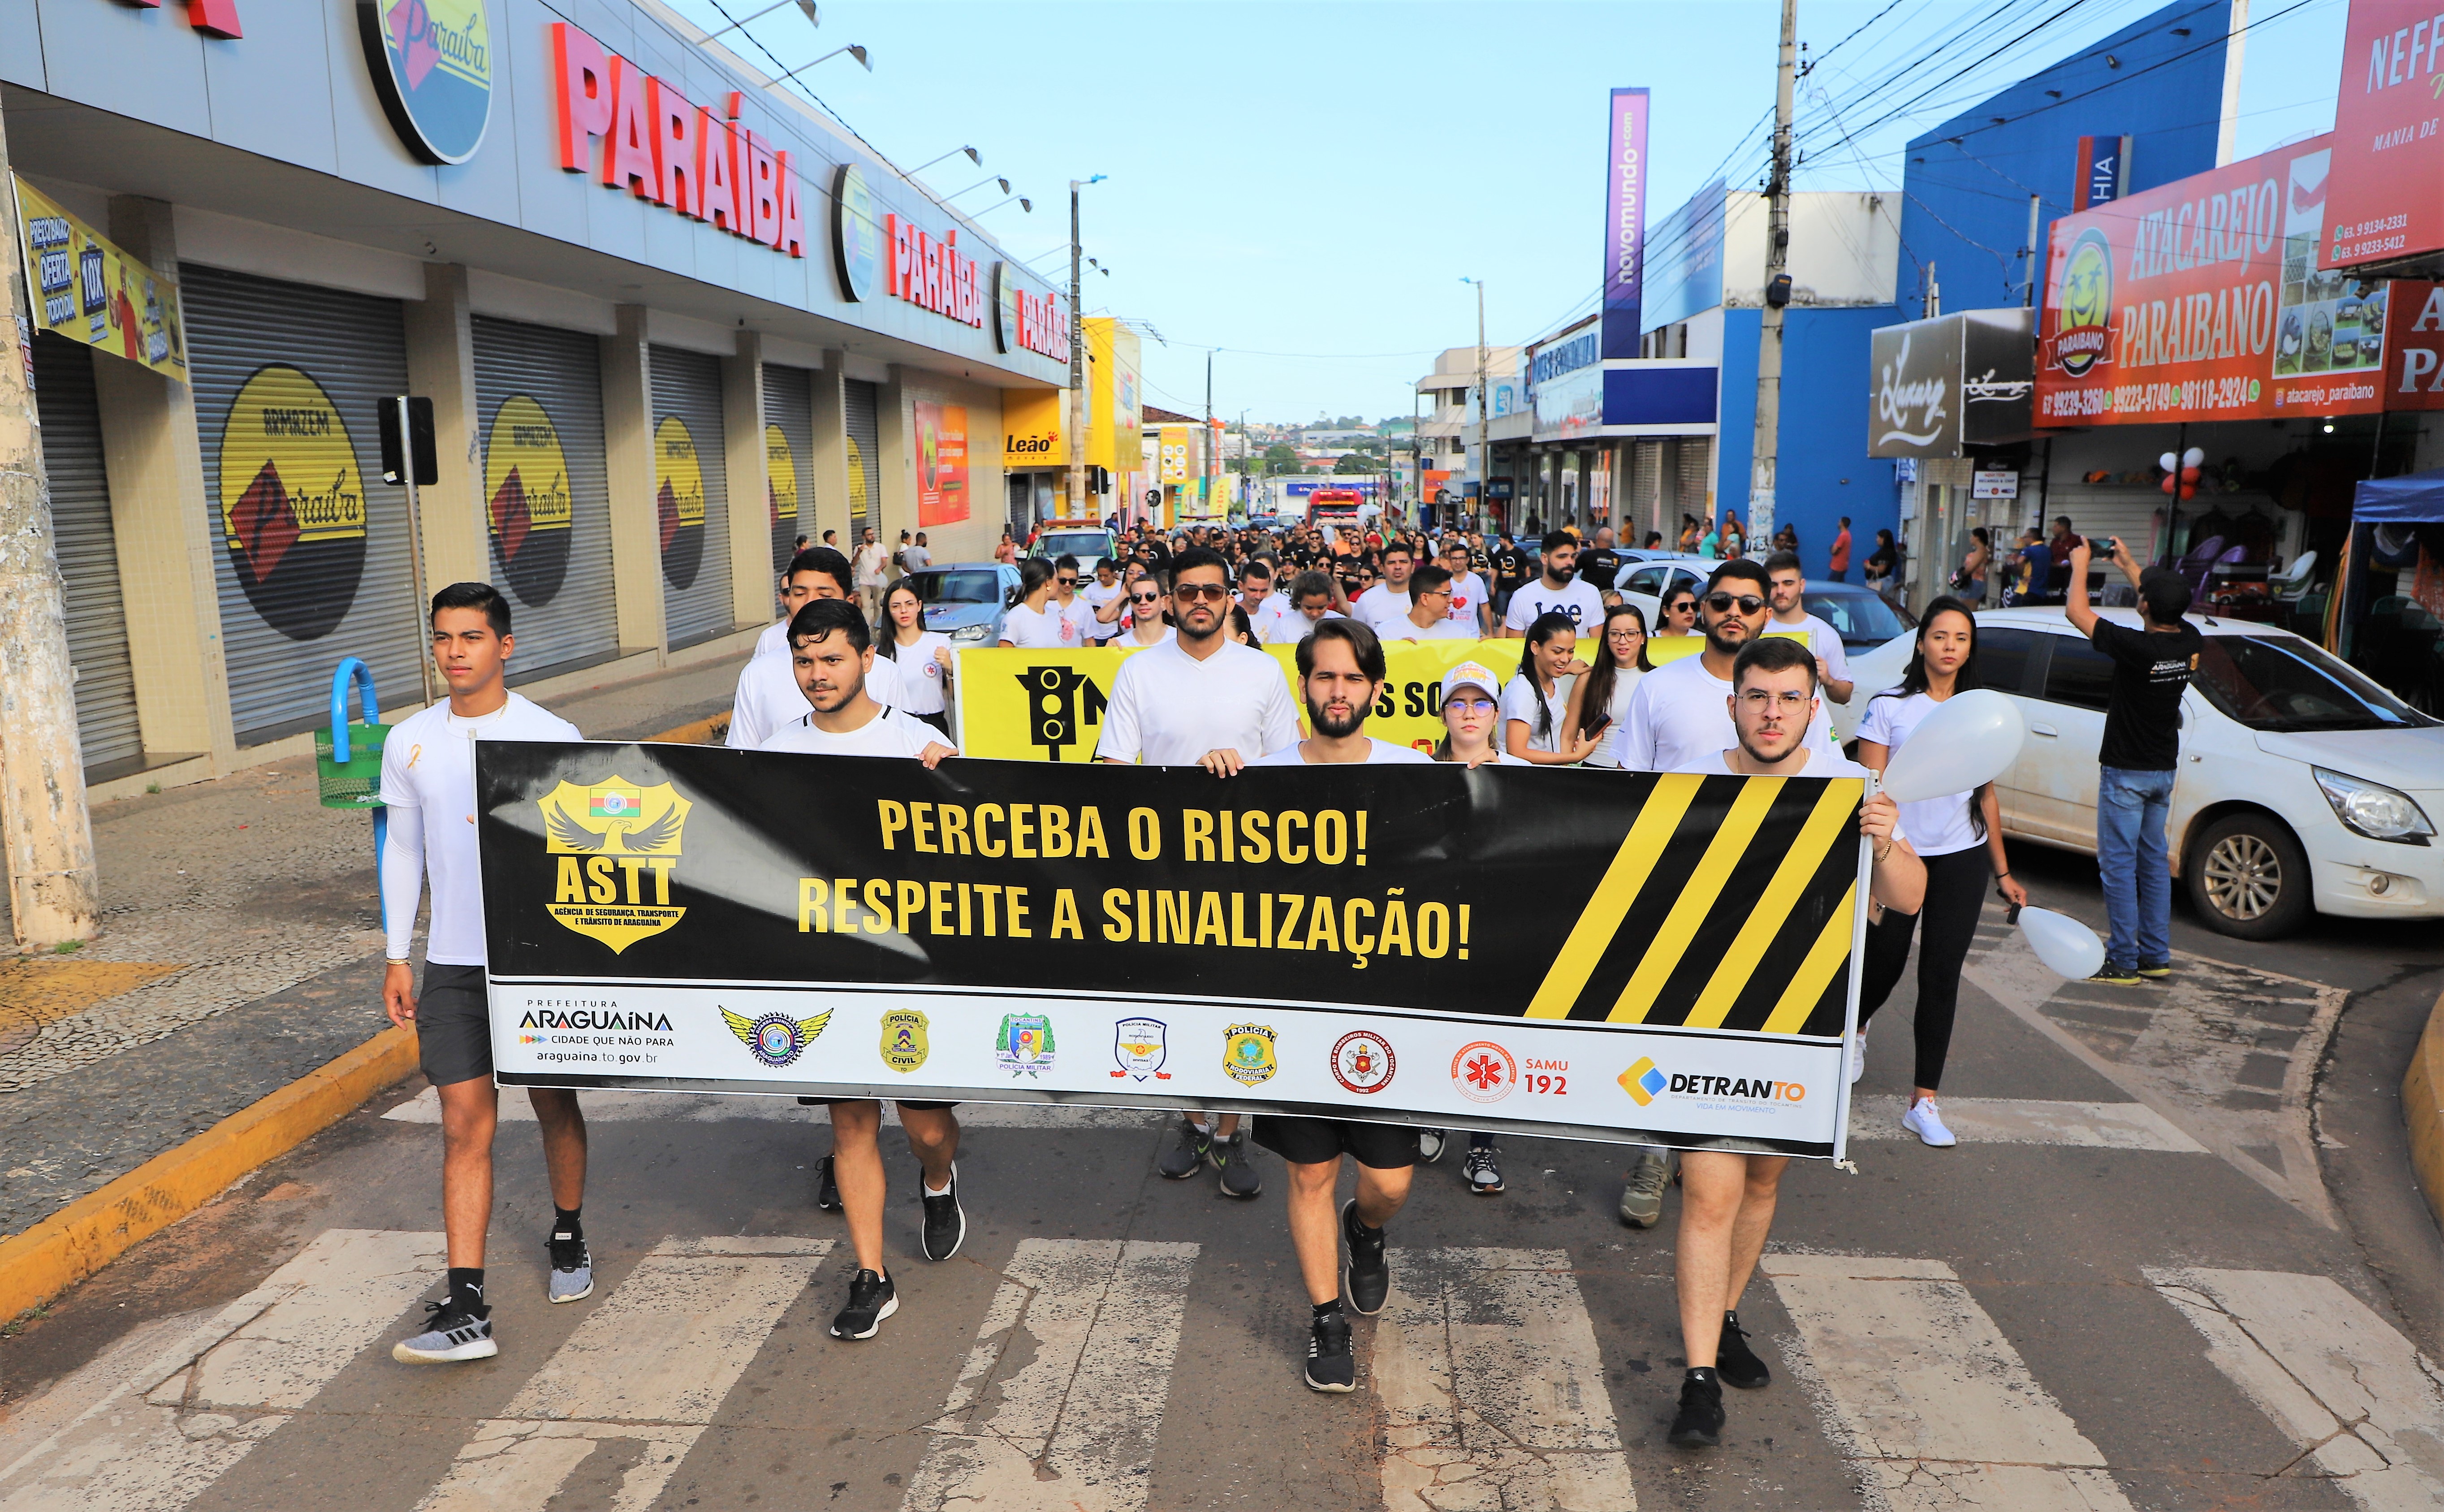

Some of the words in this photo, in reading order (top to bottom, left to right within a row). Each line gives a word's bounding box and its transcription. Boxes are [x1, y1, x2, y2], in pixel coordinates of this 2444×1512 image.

[552, 22, 807, 258] PARAÍBA
[2373, 125, 2414, 152] MANIA
[2420, 118, 2439, 139] DE
[2128, 178, 2278, 281] ATACAREJO
[40, 250, 73, 296] OFERTA
[80, 252, 106, 308] 10X
[887, 214, 984, 328] PARAÍBA
[47, 297, 65, 328] TODO
[65, 293, 76, 322] DIA
[2120, 281, 2273, 368] PARAIBANO
[2113, 382, 2171, 413] 99223-9749
[2181, 376, 2248, 410] 98118-2924
[1007, 435, 1049, 452] Leão
[878, 799, 1110, 859] PERCEBA
[1127, 807, 1161, 860] O
[1183, 808, 1368, 866] RISCO!
[556, 856, 676, 905] ASTT
[554, 907, 583, 916] AGÊNCIA
[595, 909, 636, 917] SEGURANÇA,
[637, 910, 679, 918] TRANSPORTE
[580, 917, 612, 925] TRÂNSITO
[623, 918, 661, 926] ARAGUAÍNA
[798, 877, 1032, 938] RESPEITE
[1050, 889, 1084, 940] A
[1102, 887, 1471, 970] SINALIZAÇÃO!
[756, 1019, 773, 1034] GUARDA
[773, 1018, 796, 1035] MUNICIPAL
[890, 1013, 919, 1024] POLÍCIA
[552, 1036, 589, 1044] CIDADE
[593, 1037, 614, 1045] QUE
[619, 1036, 641, 1045] NÃO
[646, 1037, 674, 1046] PARA
[1334, 1032, 1362, 1054] BOMBEIROS
[1363, 1032, 1386, 1046] MILITAR
[1462, 1043, 1490, 1053] ATENDIMENTO
[537, 1051, 658, 1064] araguaina.to.gov.br
[1332, 1054, 1337, 1063] DE
[1384, 1046, 1392, 1054] DO
[1332, 1064, 1345, 1083] CORPO
[1381, 1055, 1395, 1086] TOCANTINS
[1525, 1058, 1568, 1071] SAMU
[1525, 1075, 1567, 1095] 192
[1728, 1105, 1776, 1114] MOVIMENTO
